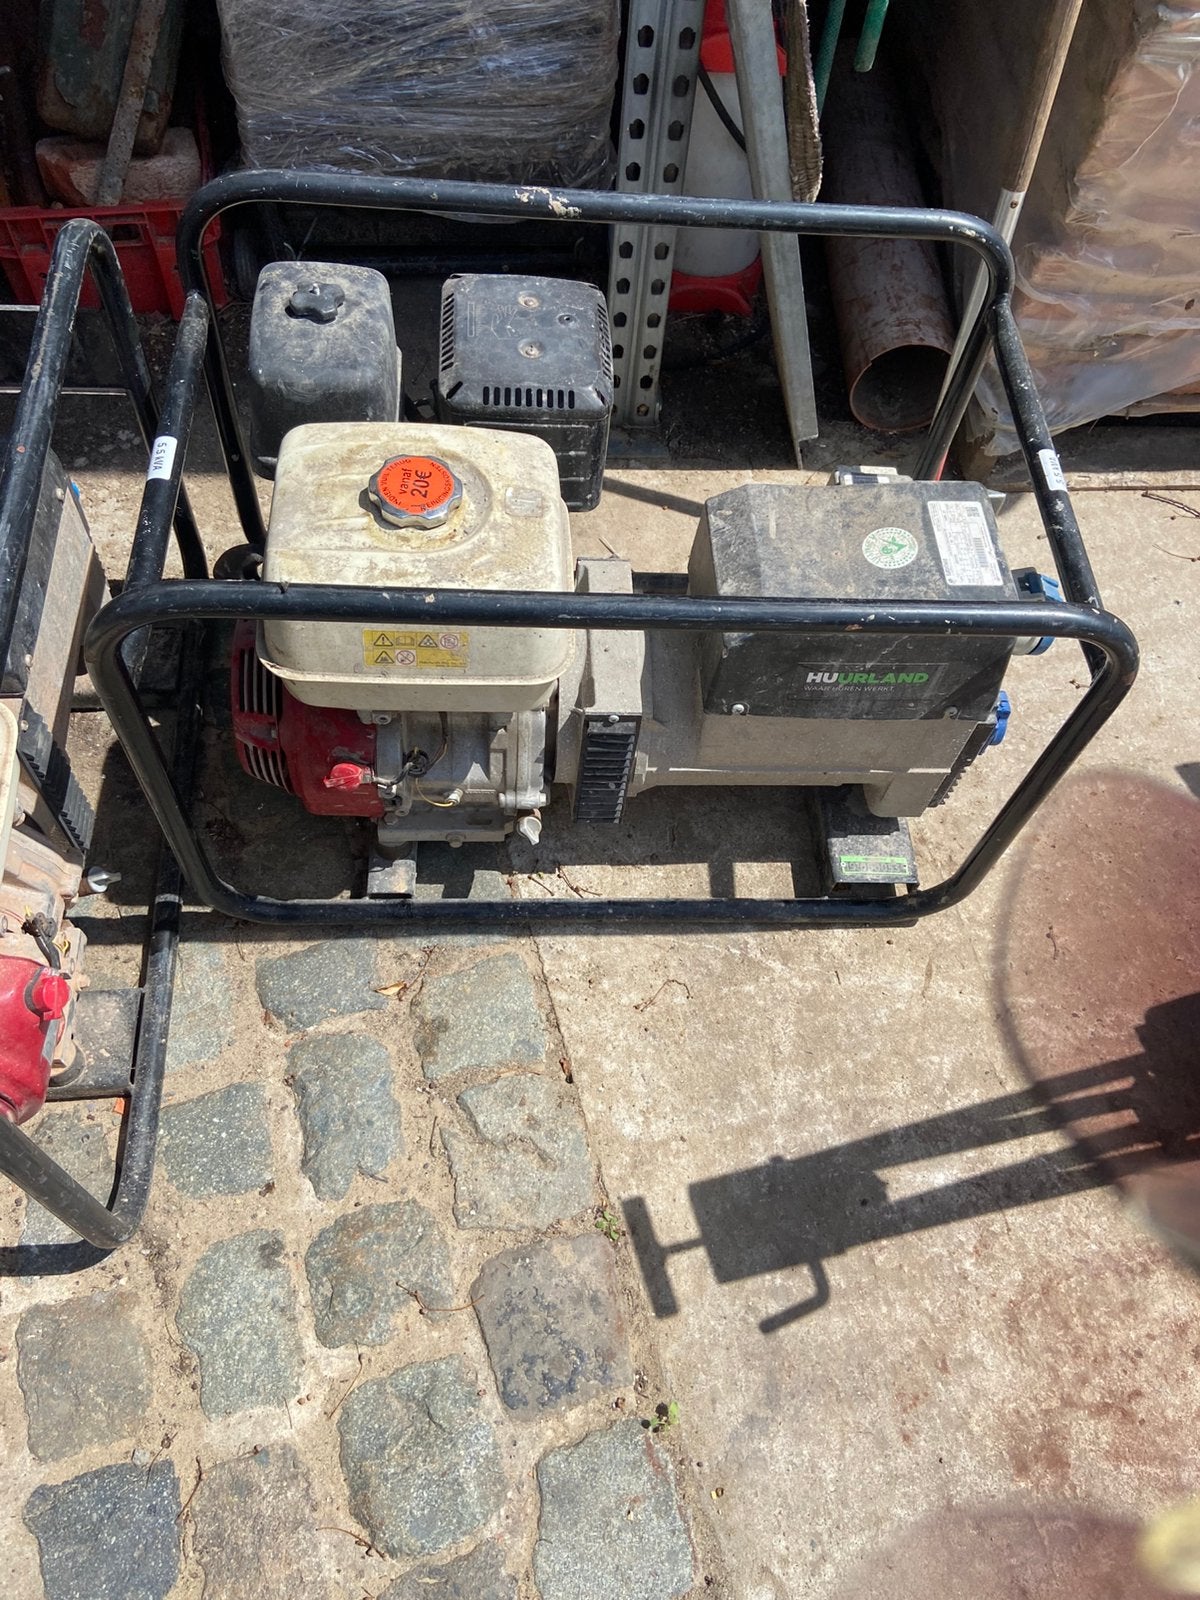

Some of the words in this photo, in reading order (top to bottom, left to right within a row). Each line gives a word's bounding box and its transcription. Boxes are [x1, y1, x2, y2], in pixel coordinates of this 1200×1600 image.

[398, 467, 413, 495] vanaf
[410, 469, 432, 499] 20€
[806, 672, 930, 684] HUURLAND
